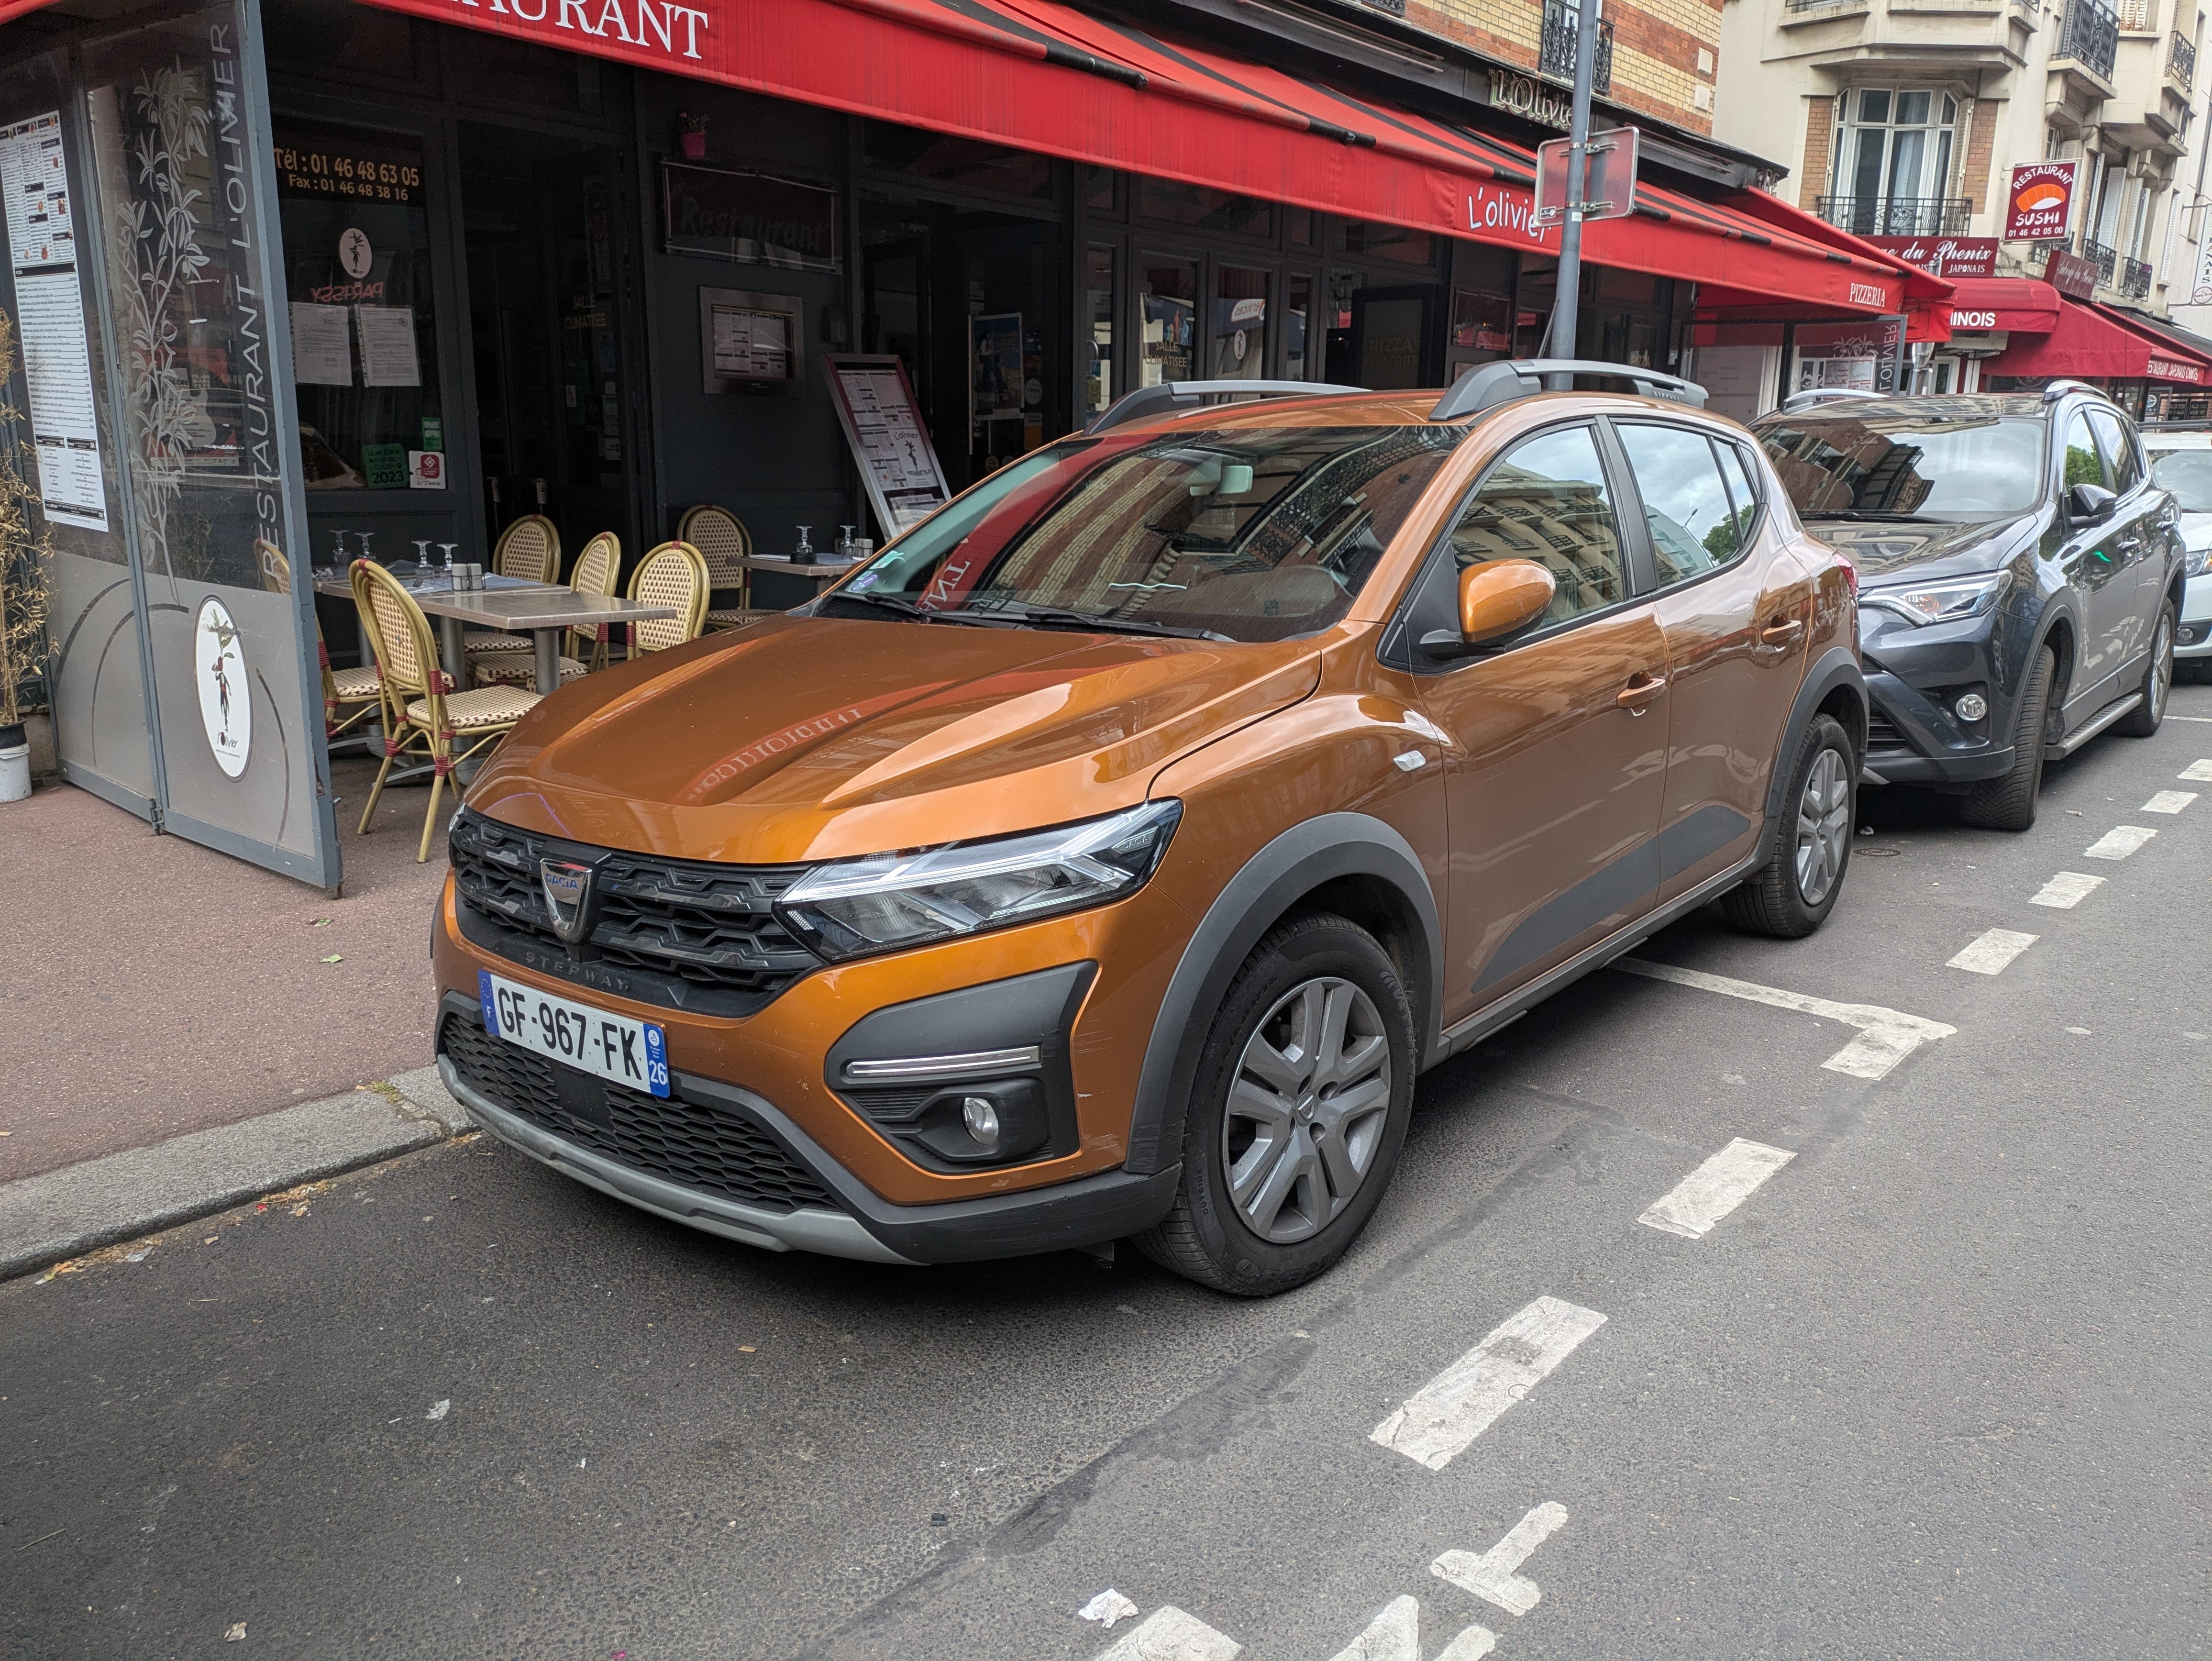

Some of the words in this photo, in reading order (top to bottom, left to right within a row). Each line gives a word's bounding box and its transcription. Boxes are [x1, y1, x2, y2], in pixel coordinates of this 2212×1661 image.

[454, 0, 708, 59] URANT
[1489, 67, 1572, 132] L'Olivie
[335, 157, 353, 177] 46
[358, 161, 376, 180] 48
[379, 164, 397, 183] 63
[401, 167, 419, 186] 05
[2013, 166, 2073, 189] RESTAURANT
[340, 182, 355, 194] 46
[359, 183, 373, 196] 48
[376, 186, 390, 198] 38
[395, 188, 408, 200] 16
[2015, 211, 2059, 226] SUSHI
[1902, 241, 1928, 259] du
[1933, 240, 1993, 260] Phenix
[1948, 264, 1985, 274] JAPONAIS
[1849, 282, 1885, 308] PIZZERIA
[1950, 311, 1995, 327] INOIS
[1155, 341, 1178, 352] SALLE
[371, 471, 404, 484] 2023
[545, 873, 579, 891] DACIA
[525, 952, 628, 990] STEPWAY
[498, 987, 642, 1080] GF-967-FK
[649, 1060, 667, 1085] 26
